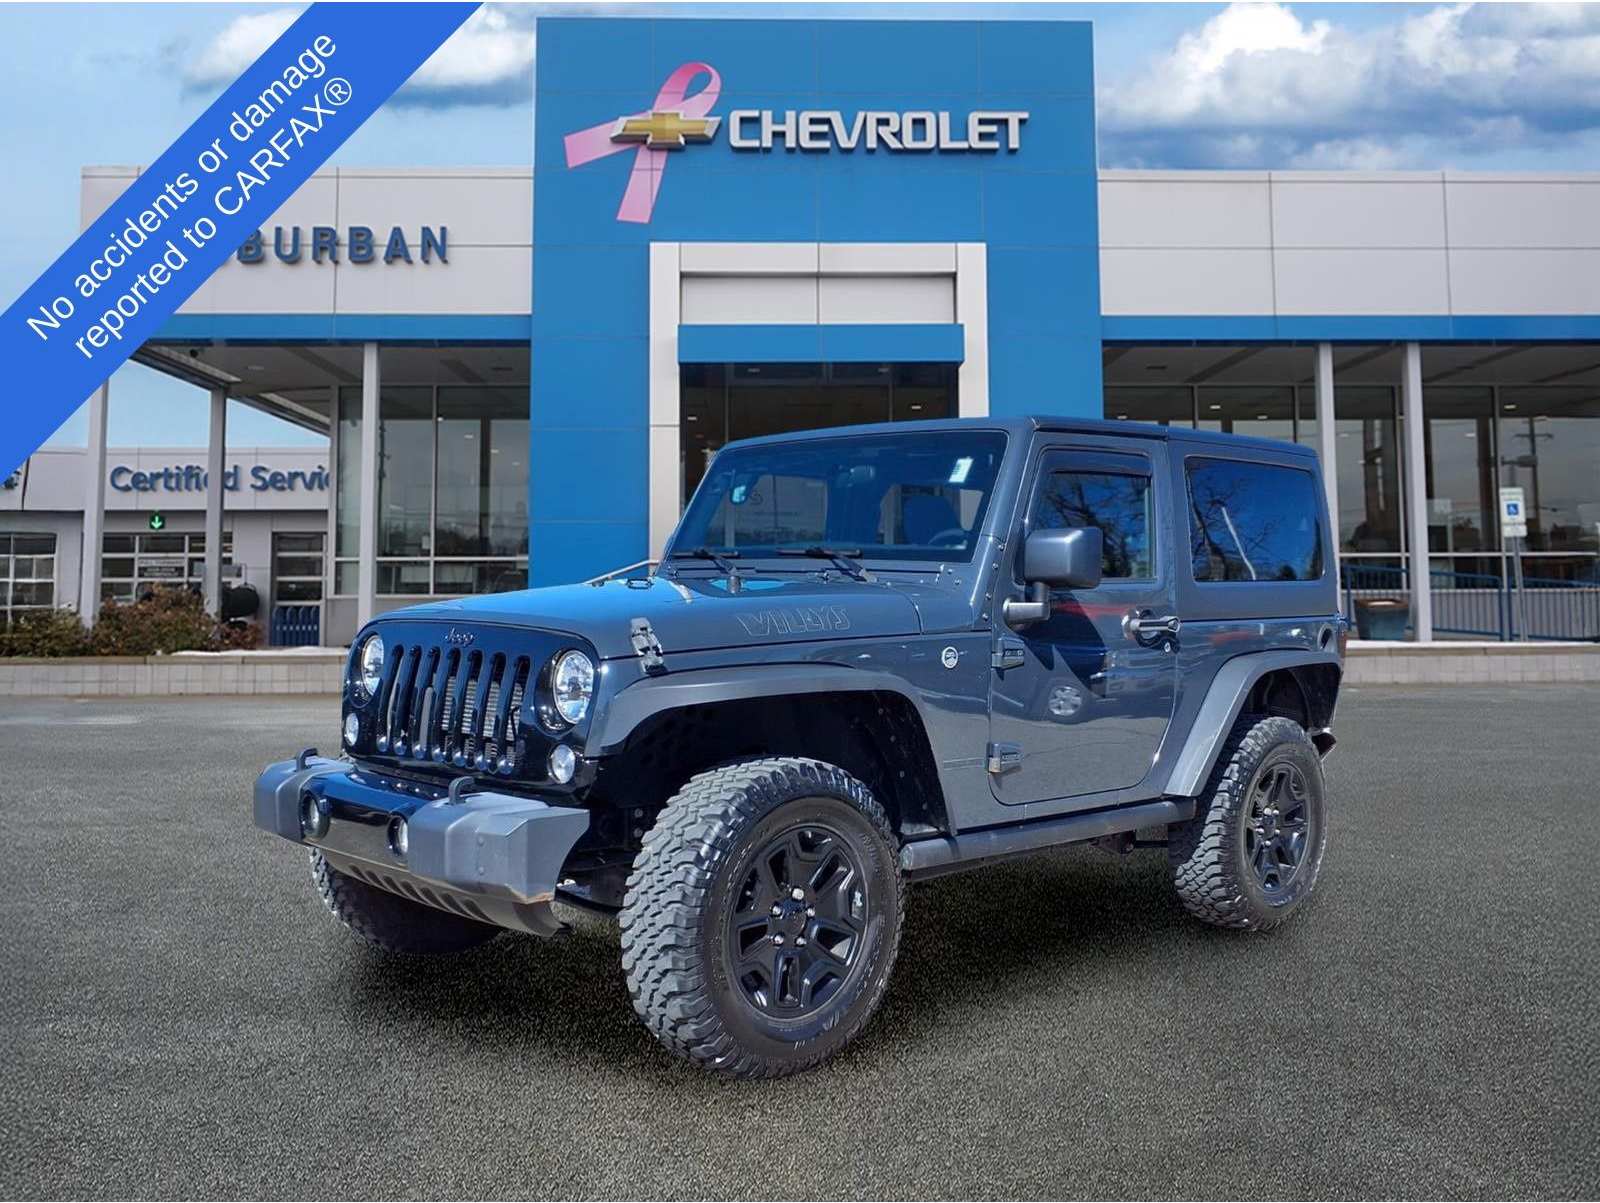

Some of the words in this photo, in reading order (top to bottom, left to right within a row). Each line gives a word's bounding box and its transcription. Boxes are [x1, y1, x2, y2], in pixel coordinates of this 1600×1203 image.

[729, 109, 1029, 152] CHEVROLET
[237, 226, 449, 264] BURBAN
[250, 465, 330, 492] Servi
